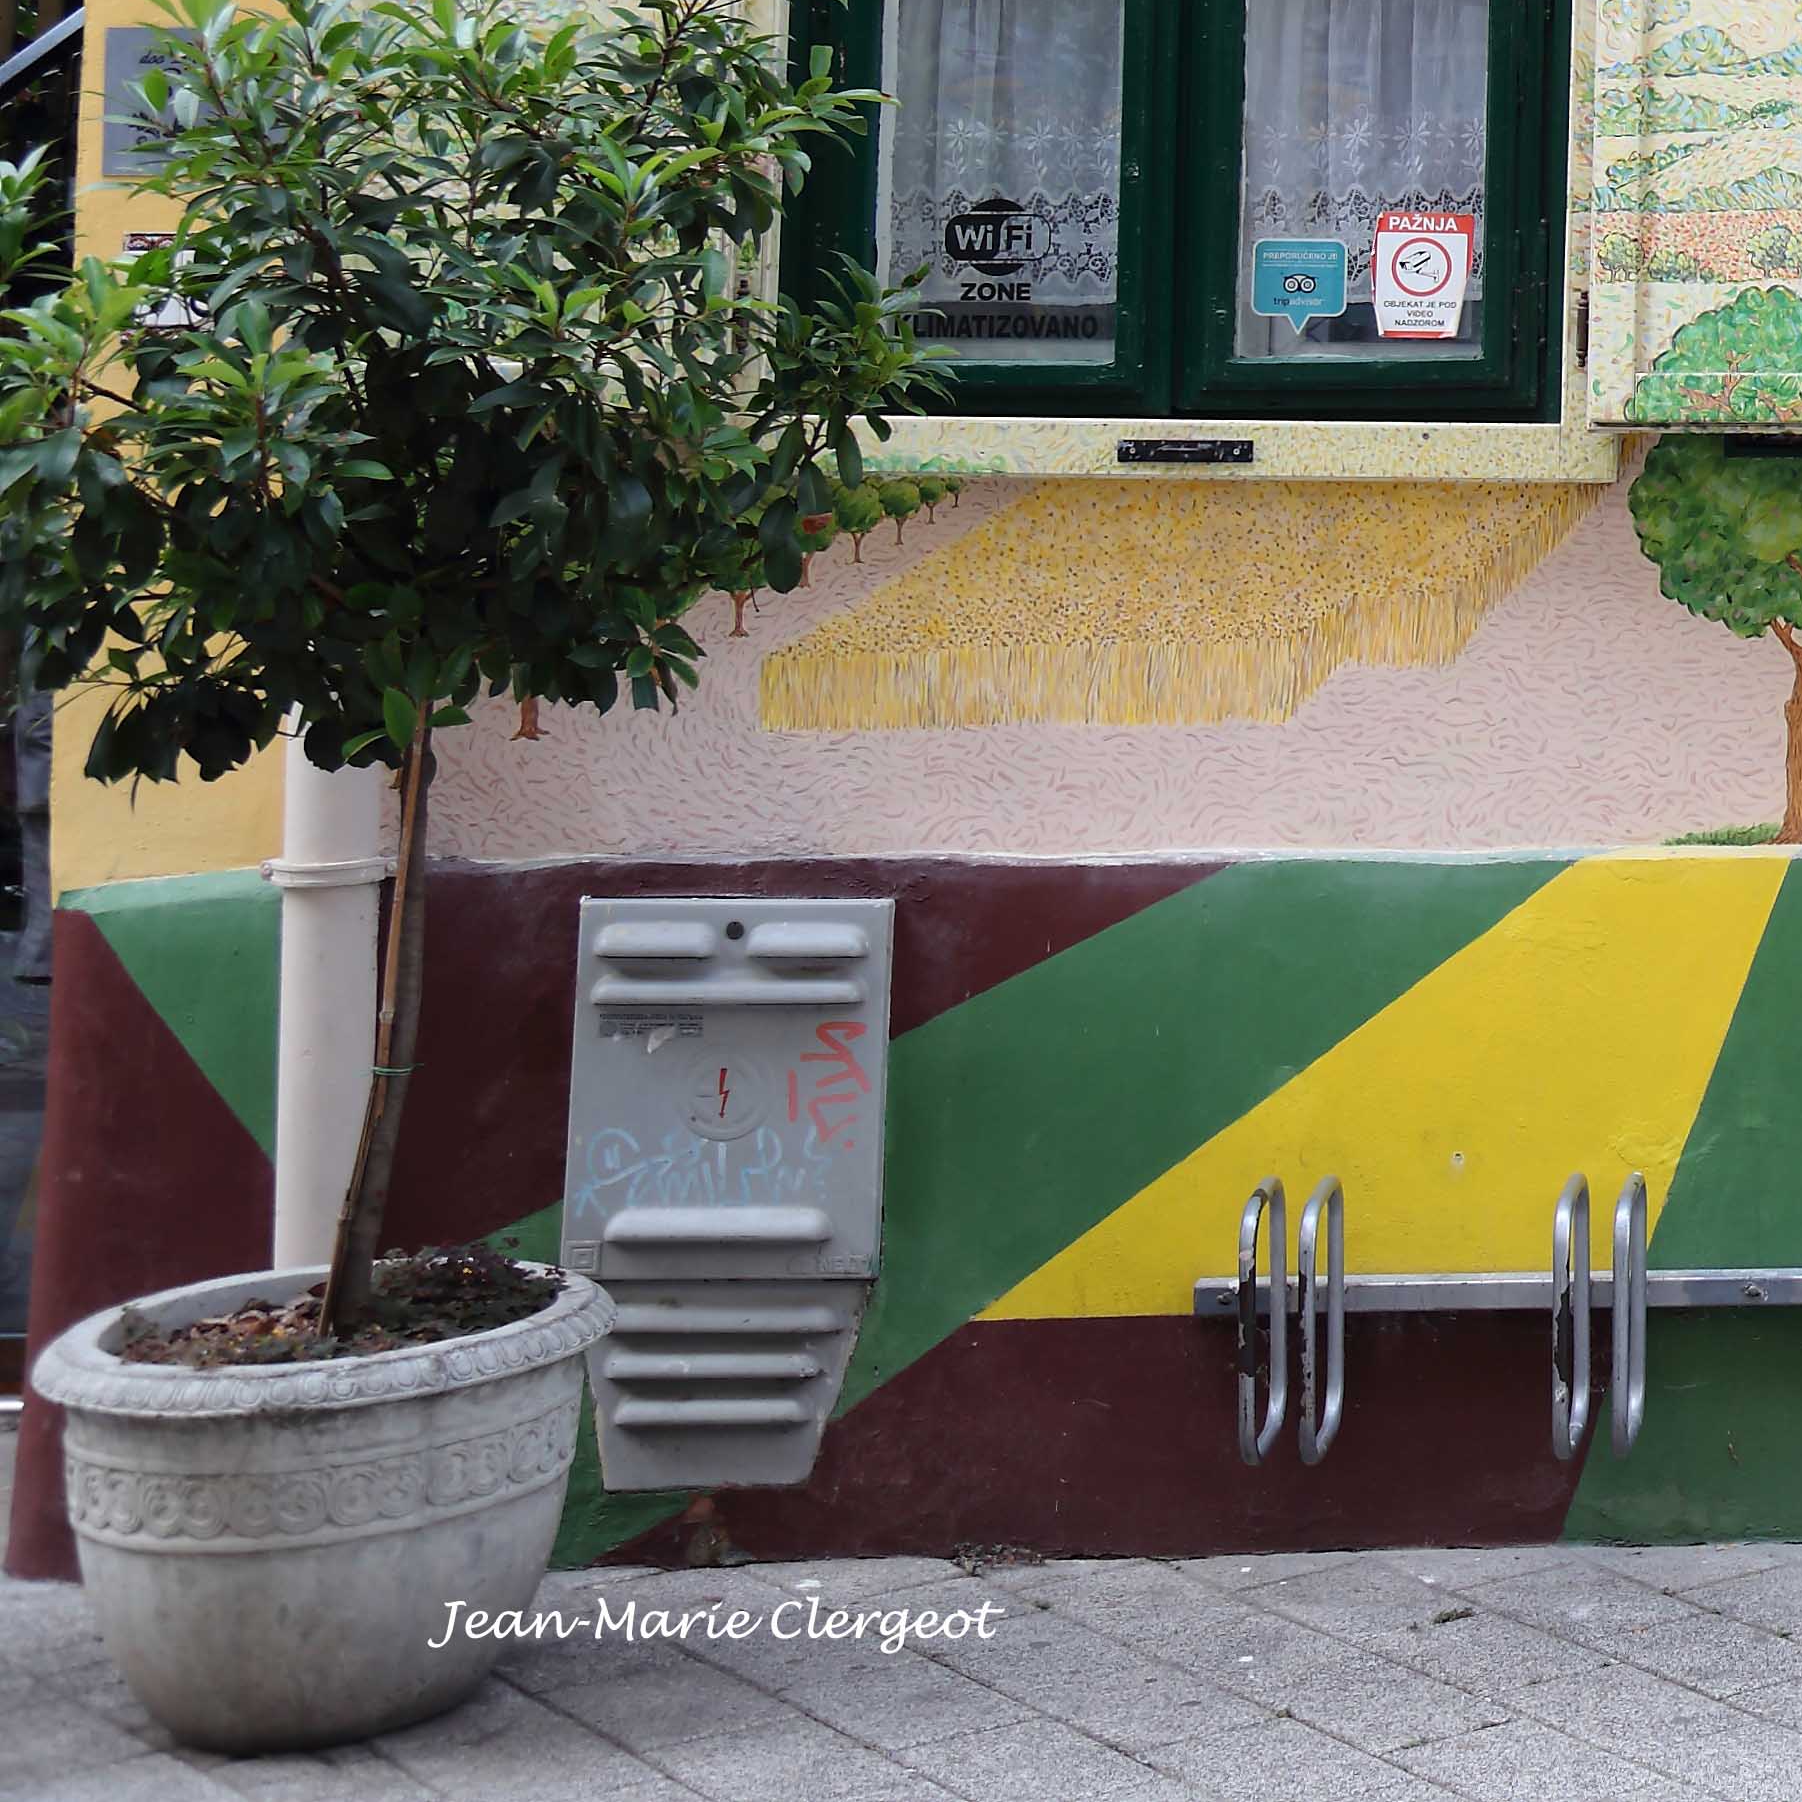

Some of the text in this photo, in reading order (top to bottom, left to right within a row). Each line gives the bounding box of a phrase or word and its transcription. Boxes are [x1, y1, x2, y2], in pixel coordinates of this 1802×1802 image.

[1389, 214, 1458, 231] PAŽNJA
[960, 283, 1032, 301] ZONE
[1383, 300, 1424, 308] OBJEKAT
[1425, 300, 1437, 308] JE
[1406, 309, 1434, 317] VIDEO
[1394, 319, 1445, 327] NADZOROM
